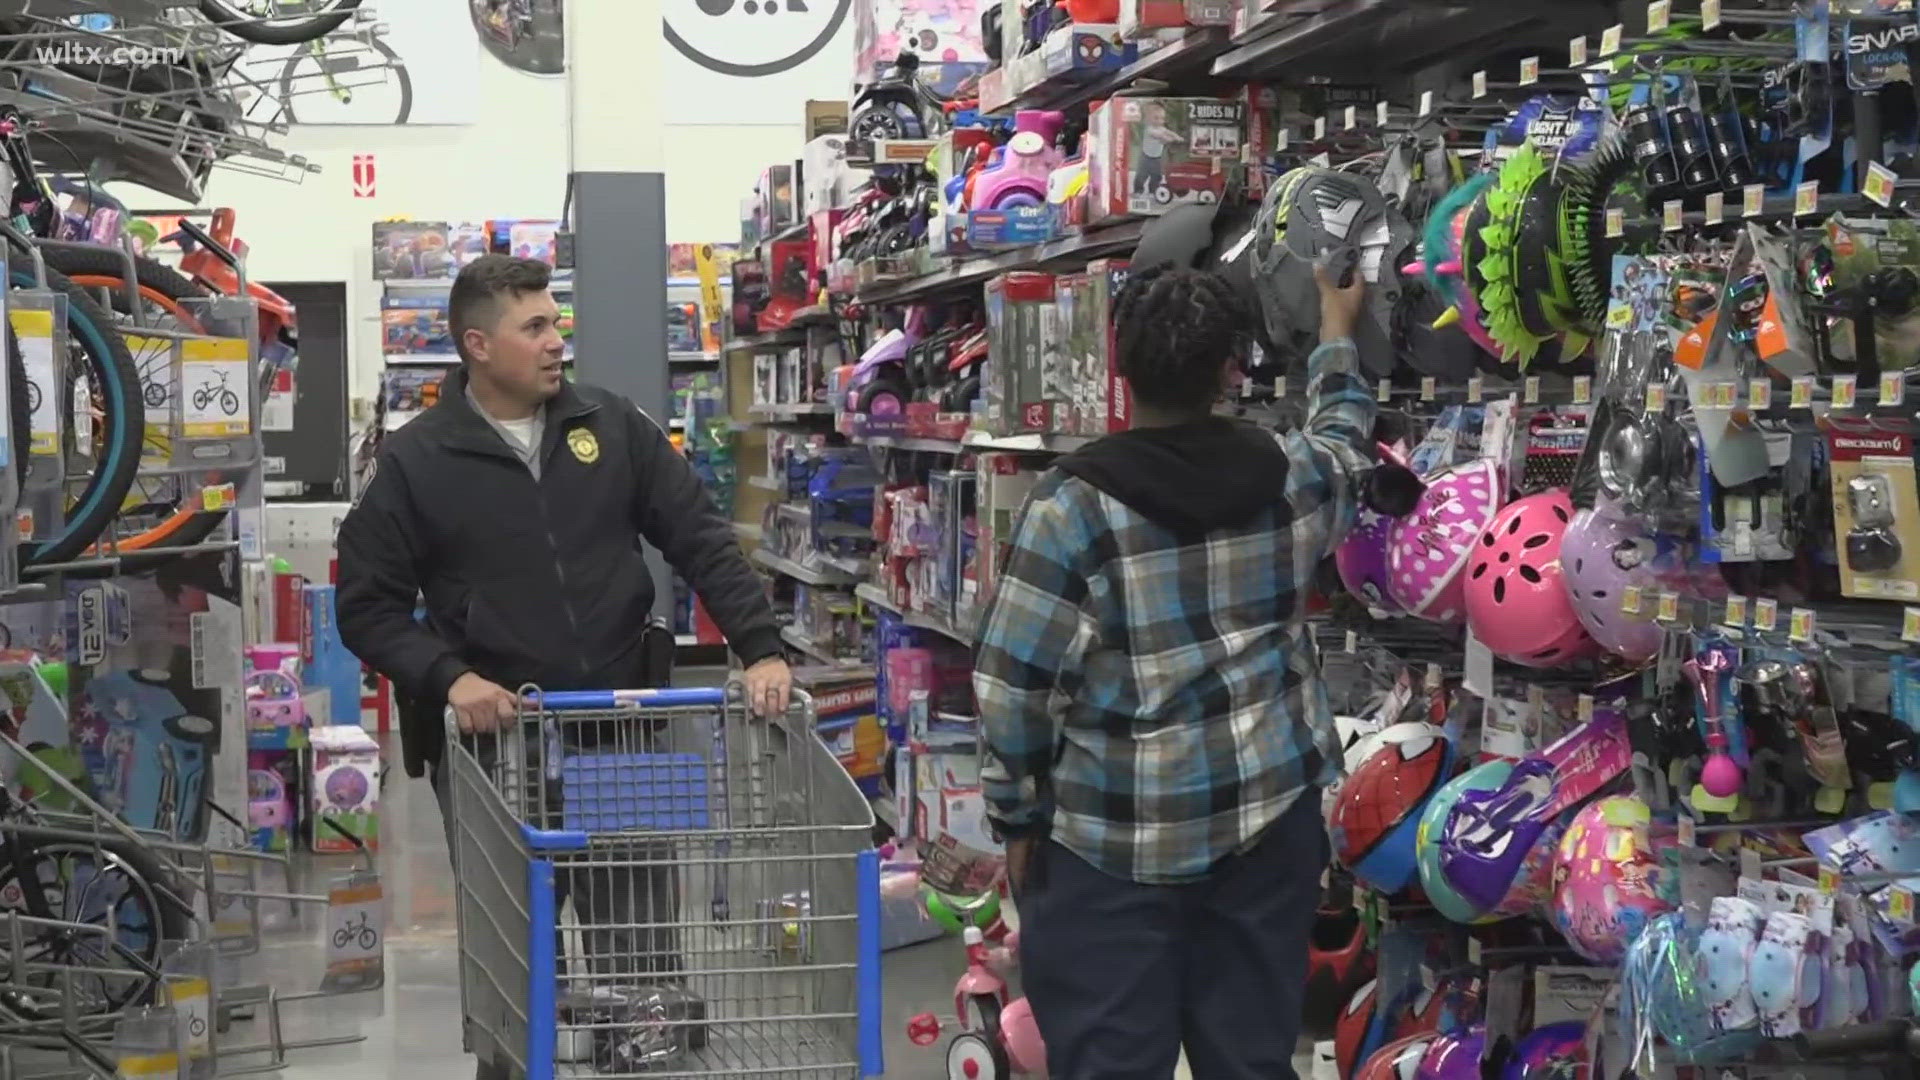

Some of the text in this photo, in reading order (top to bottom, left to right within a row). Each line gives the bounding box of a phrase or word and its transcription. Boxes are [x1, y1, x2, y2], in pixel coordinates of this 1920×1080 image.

[1188, 103, 1196, 118] 2
[1197, 105, 1223, 118] RIDES
[1527, 120, 1564, 136] LIGHT
[81, 595, 101, 662] 12 VOLT
